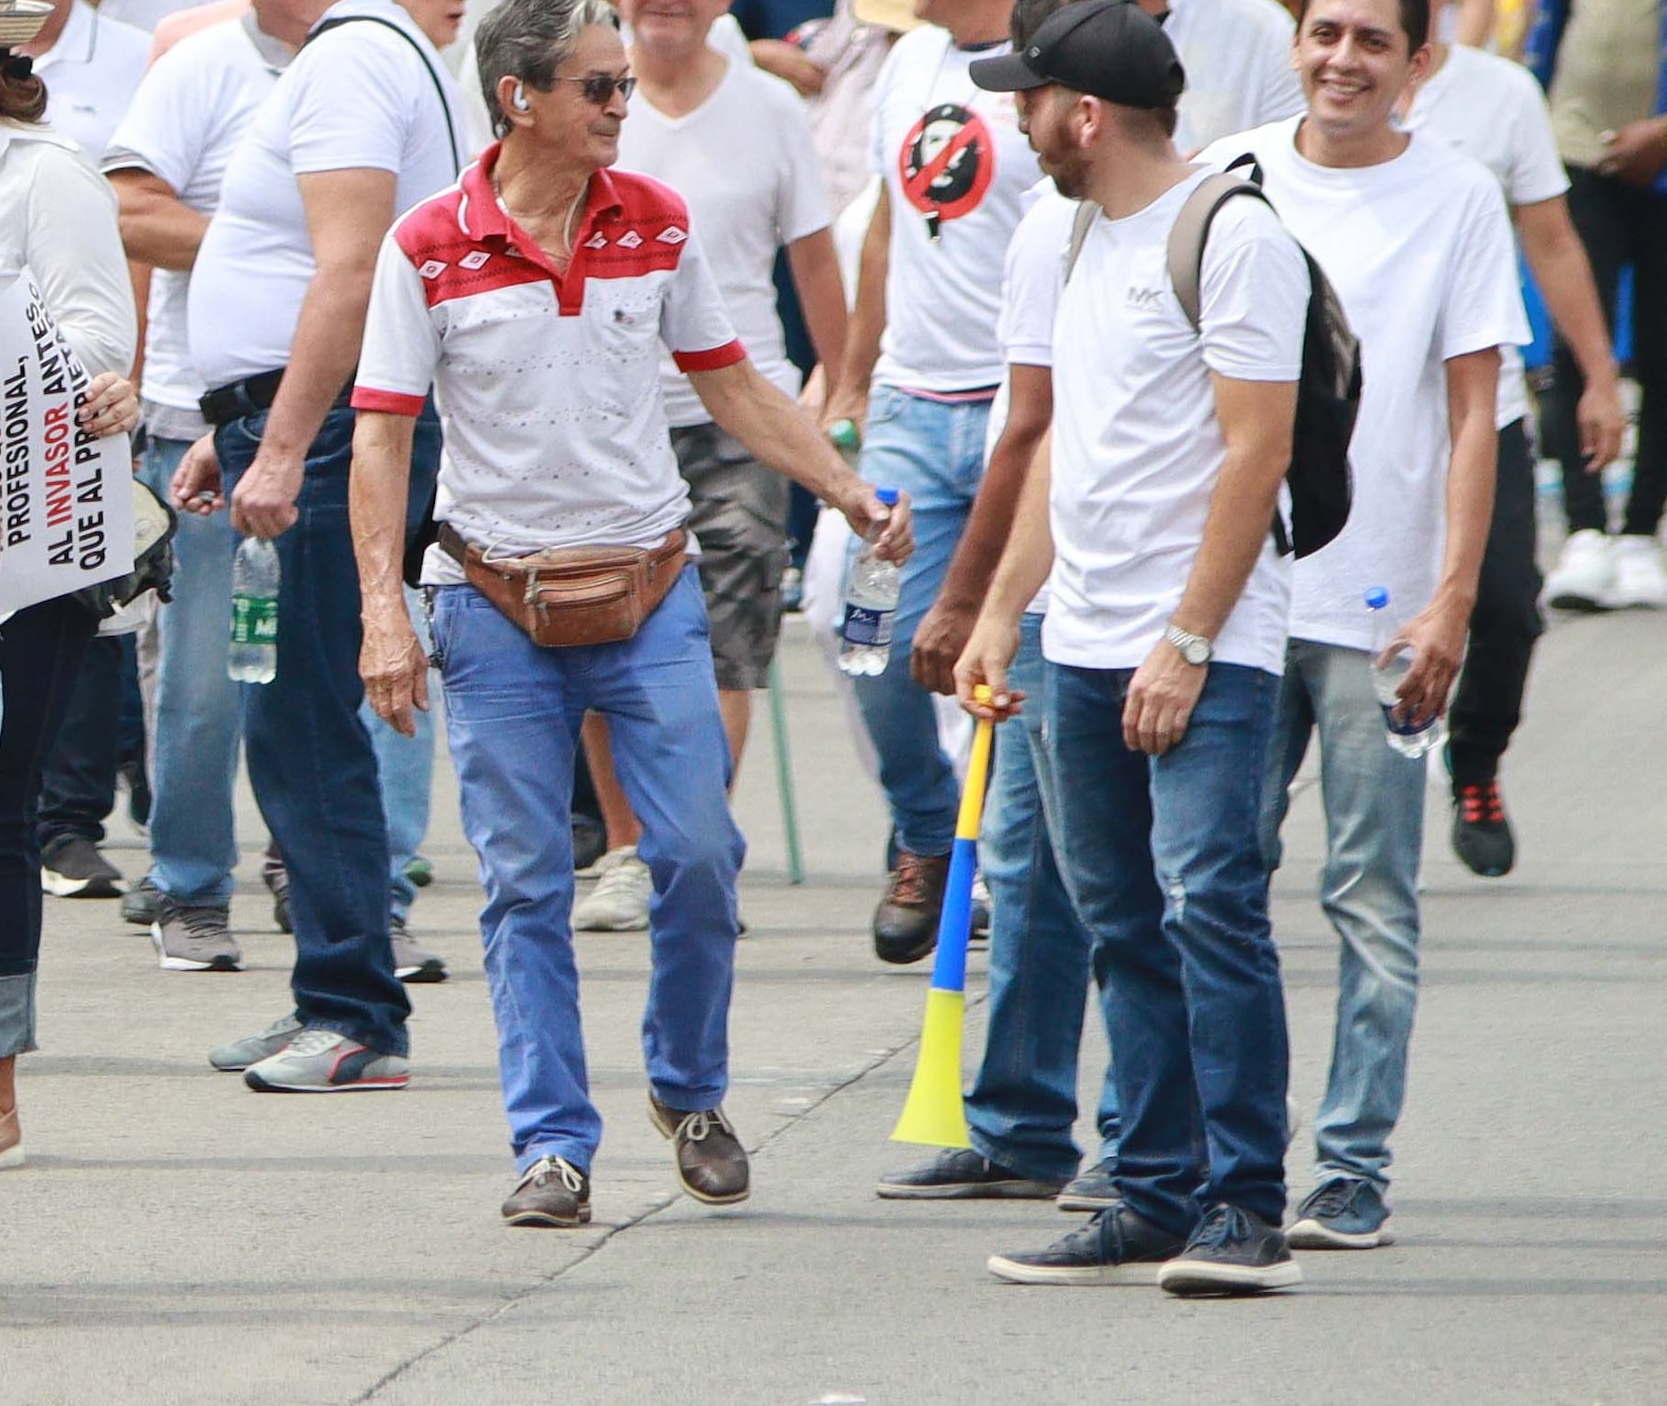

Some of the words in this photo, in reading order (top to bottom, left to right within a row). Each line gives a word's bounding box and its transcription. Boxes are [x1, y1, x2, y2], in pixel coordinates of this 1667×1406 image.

[26, 305, 67, 396] ANTES
[44, 401, 73, 528] INVASOR
[76, 467, 103, 504] AL
[49, 529, 74, 567] AL
[77, 510, 104, 571] QUE
